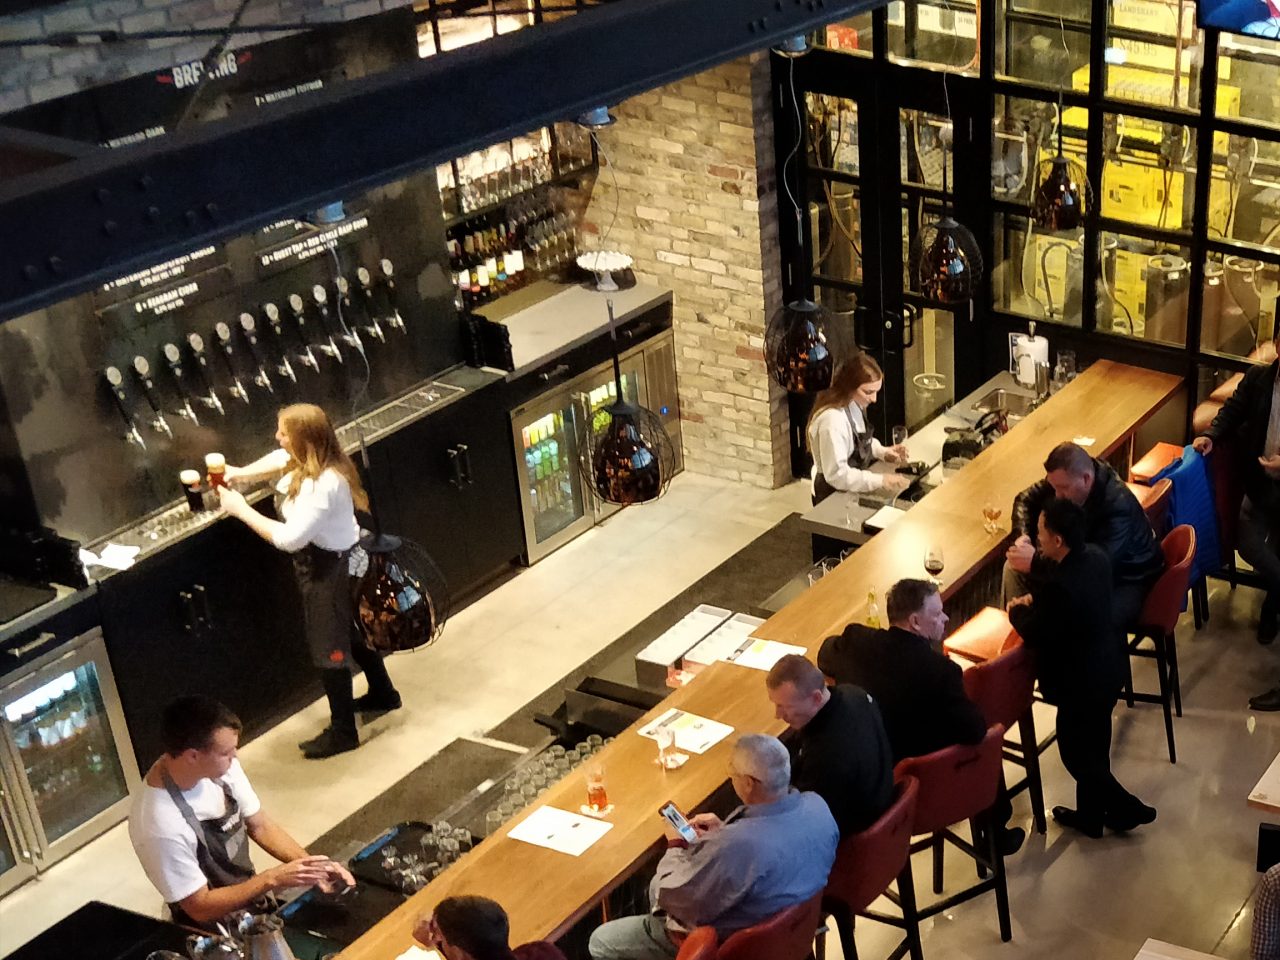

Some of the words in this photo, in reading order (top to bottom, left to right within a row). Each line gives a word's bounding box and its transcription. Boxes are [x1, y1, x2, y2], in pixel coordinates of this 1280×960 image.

[172, 53, 237, 88] BRENG
[147, 289, 178, 309] SEAGRAM
[178, 282, 199, 297] CIDER
